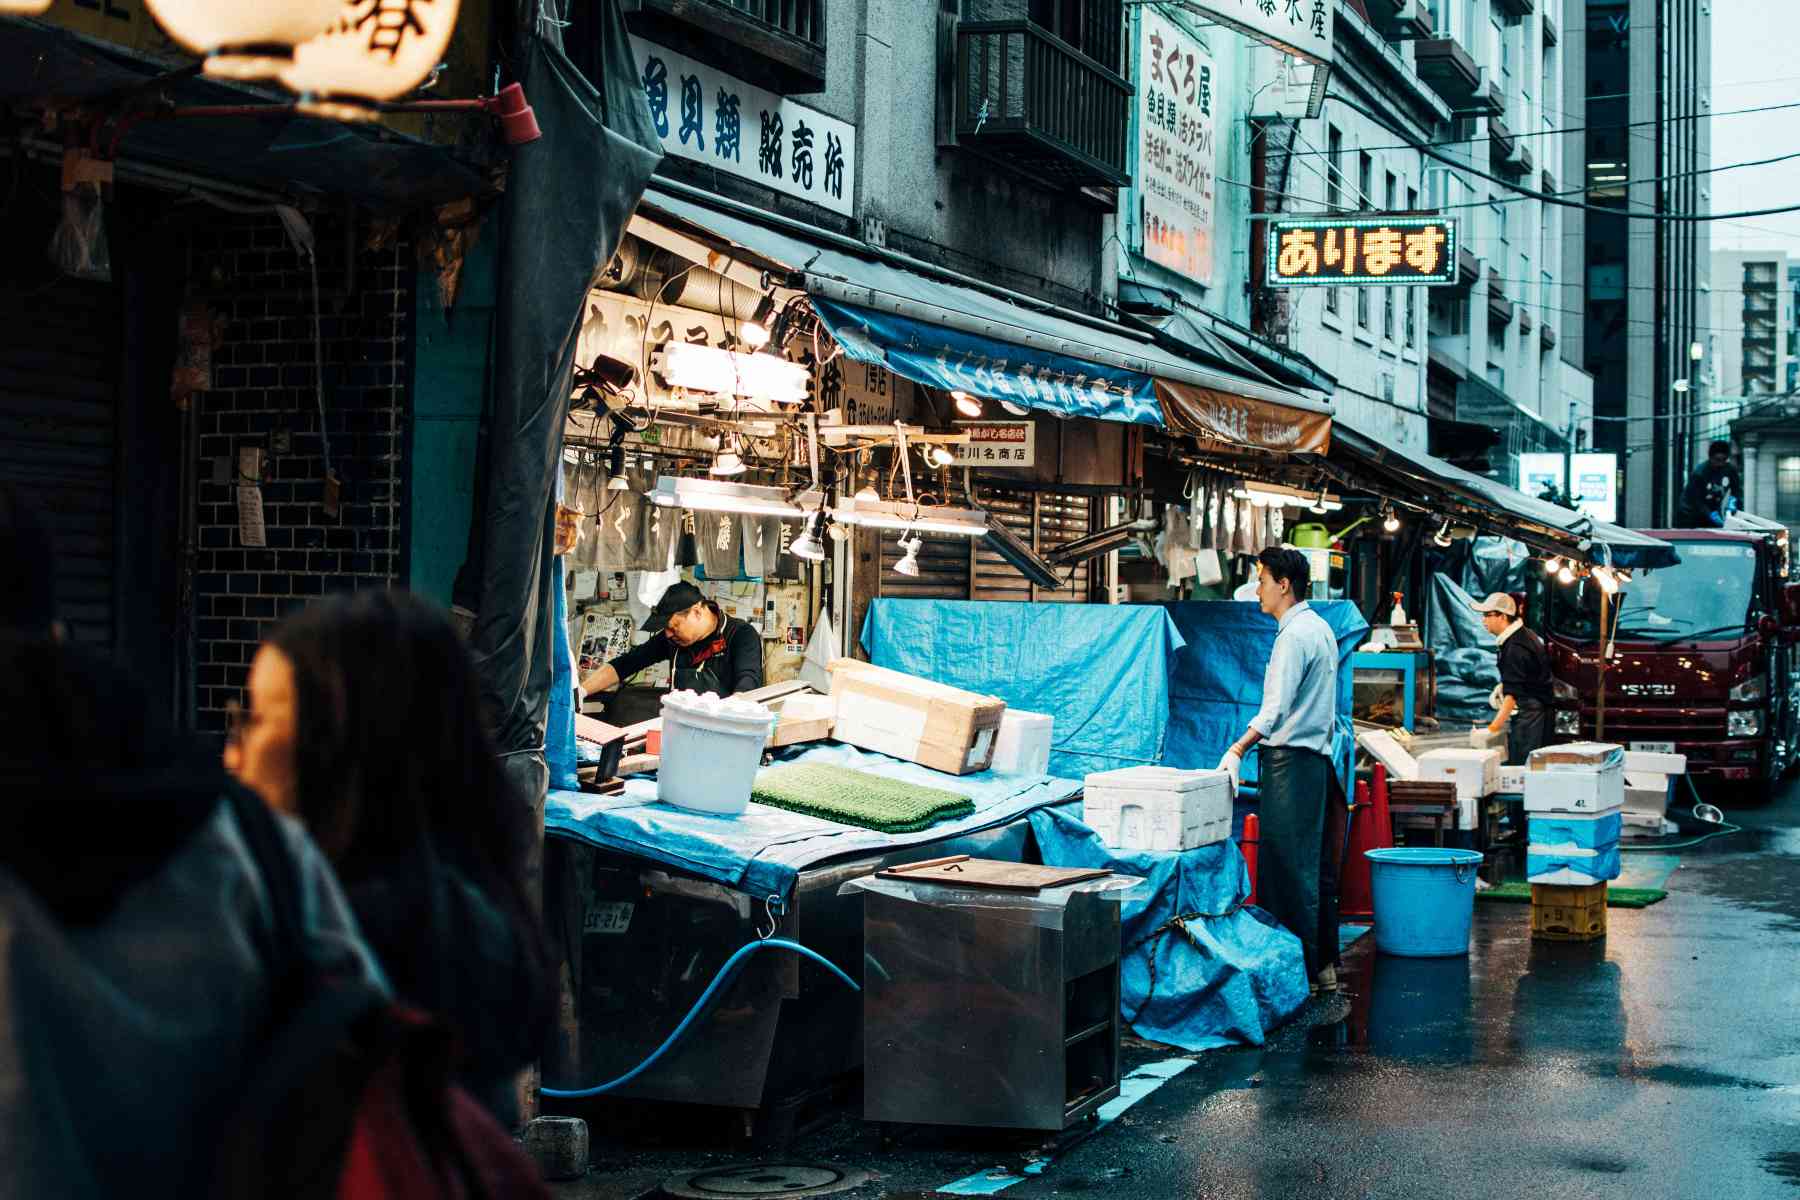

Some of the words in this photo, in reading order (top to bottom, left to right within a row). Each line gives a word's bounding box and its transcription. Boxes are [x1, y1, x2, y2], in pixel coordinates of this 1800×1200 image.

[1149, 30, 1212, 118] まぐろ屋
[1279, 227, 1445, 275] あります
[967, 447, 1026, 460] 川名商店
